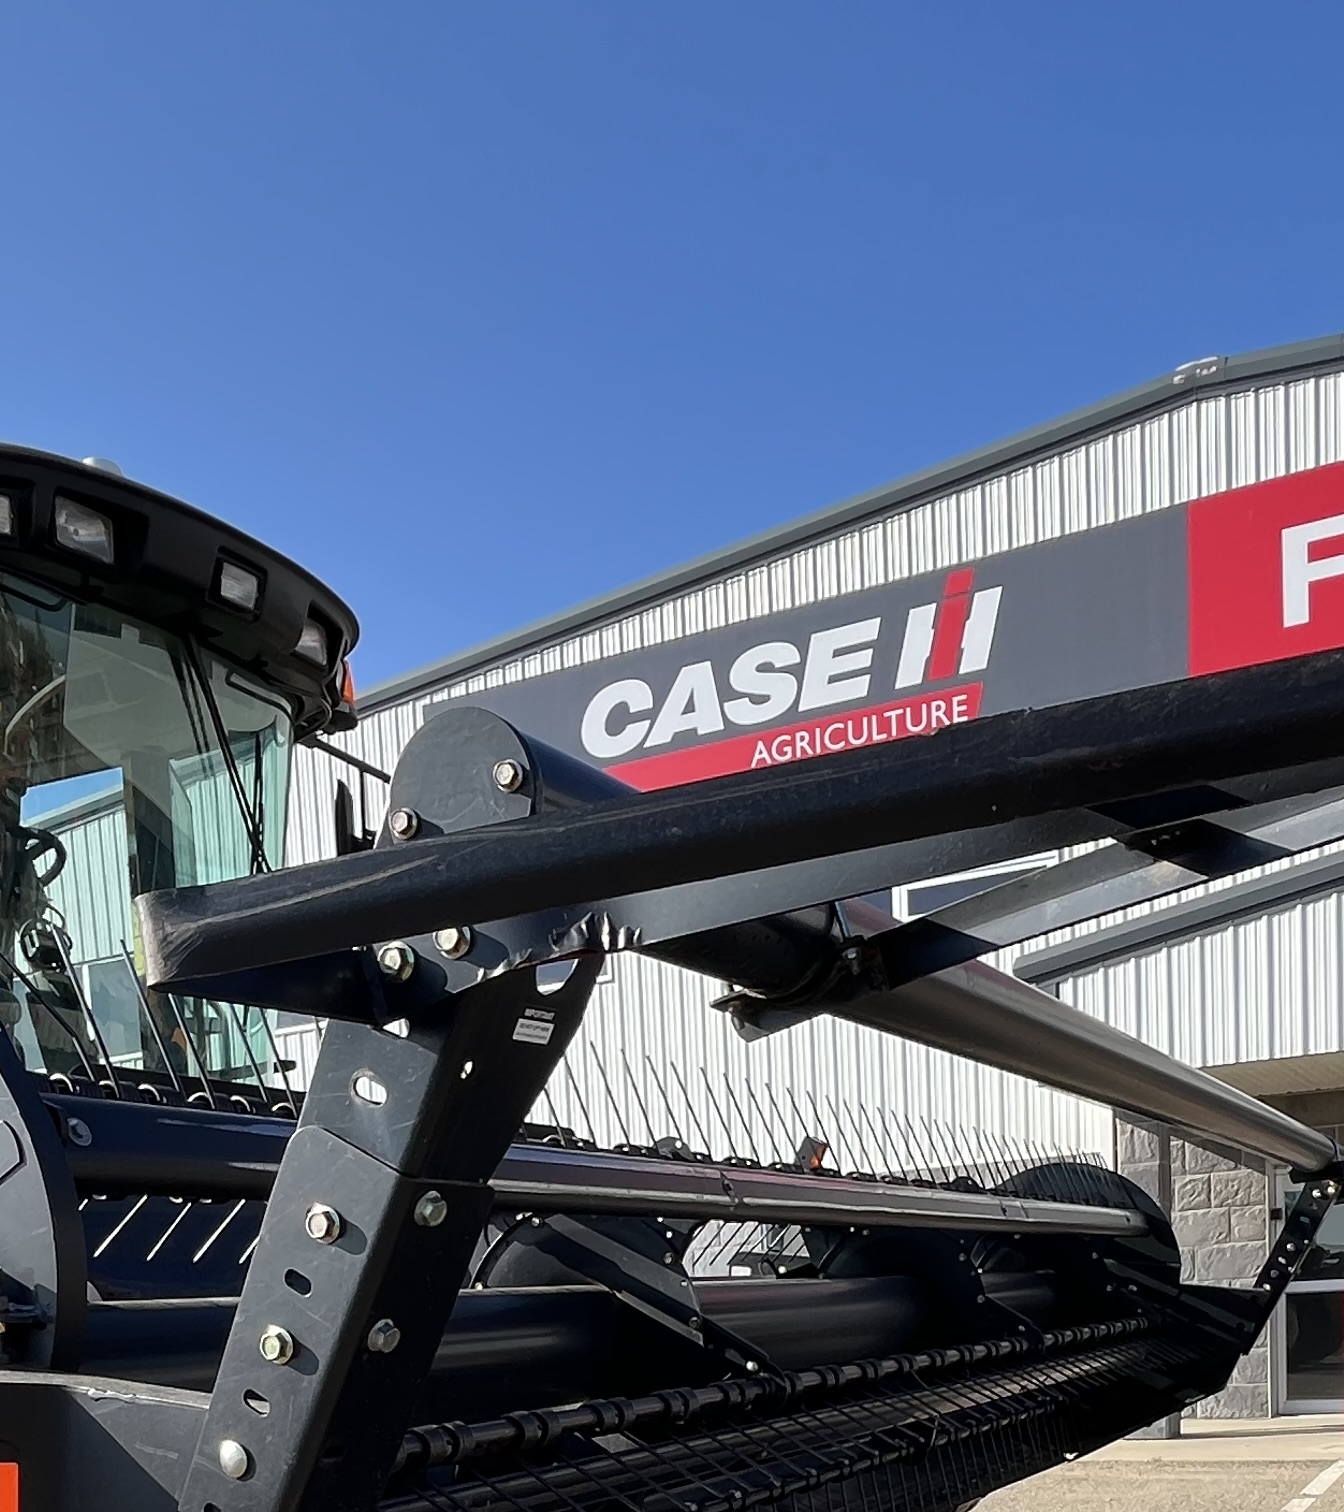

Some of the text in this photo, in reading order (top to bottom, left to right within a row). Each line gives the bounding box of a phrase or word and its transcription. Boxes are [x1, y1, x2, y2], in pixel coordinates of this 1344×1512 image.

[581, 567, 1004, 759] CASE IH
[750, 694, 970, 769] AGRICULTURE
